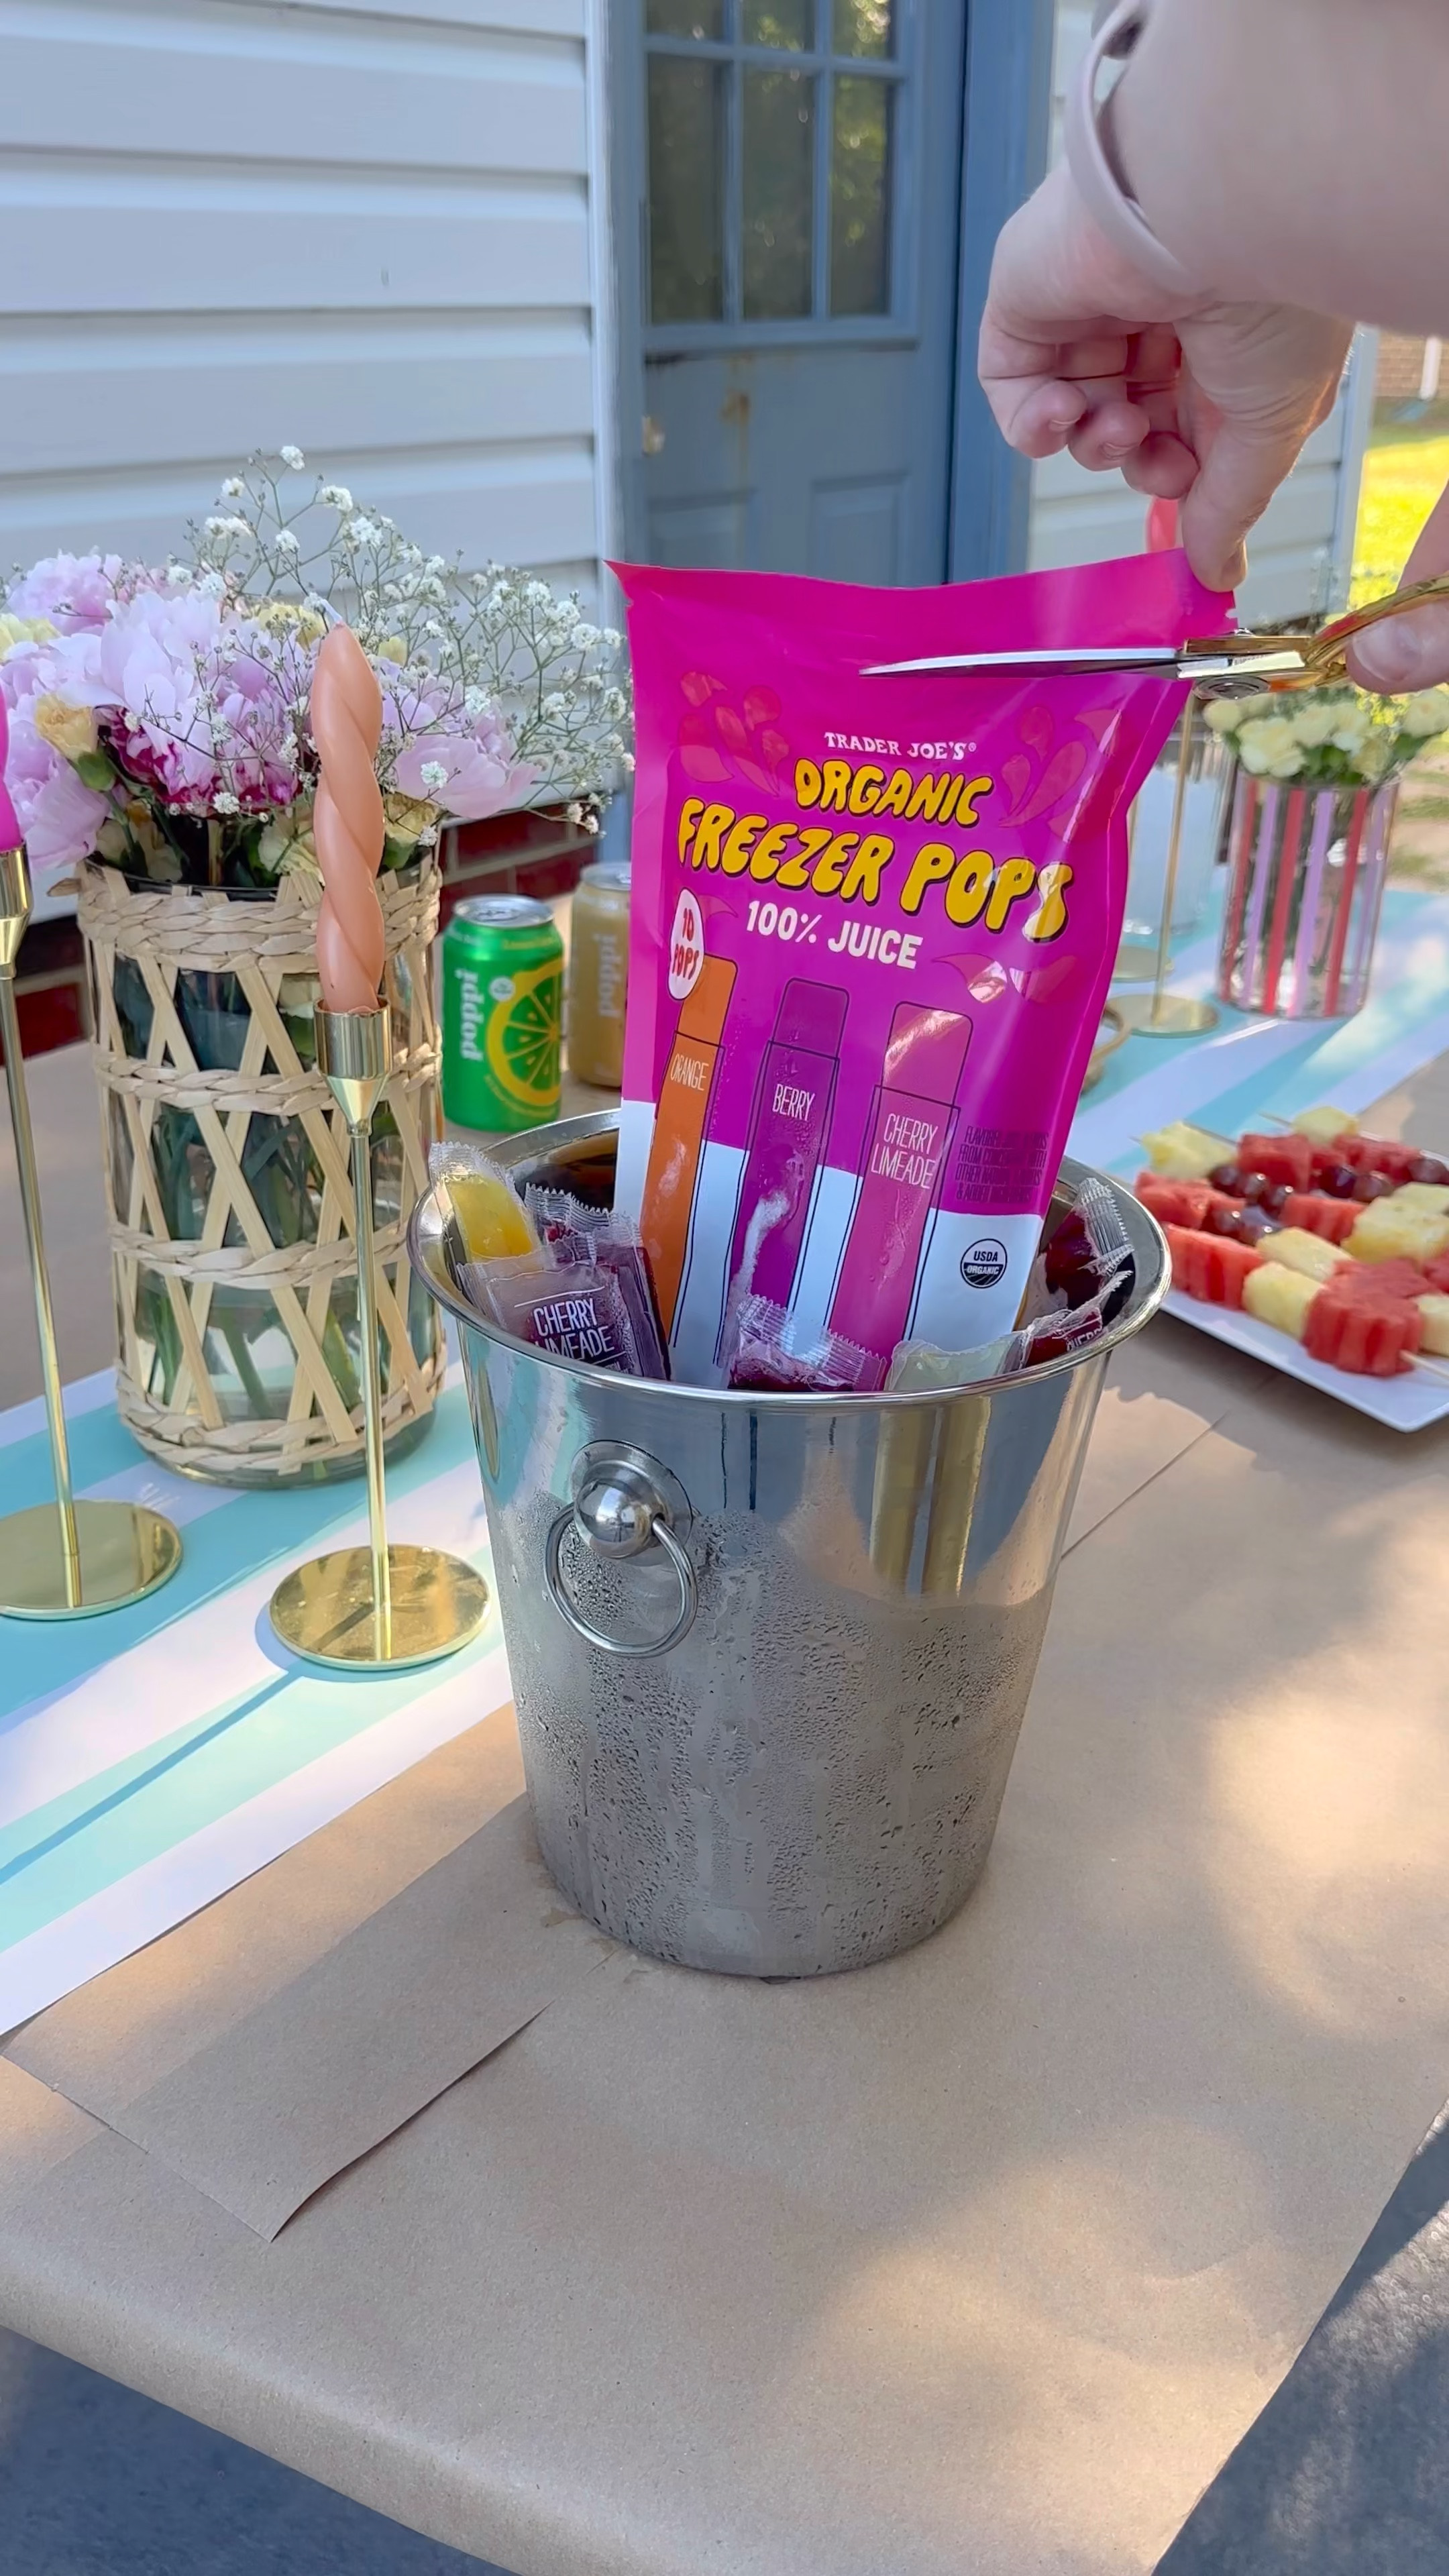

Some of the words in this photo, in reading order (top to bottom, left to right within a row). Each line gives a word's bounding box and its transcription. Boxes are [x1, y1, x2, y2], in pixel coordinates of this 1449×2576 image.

[824, 731, 902, 756] TRADER
[794, 758, 994, 827] ORGANIC
[677, 797, 895, 903] FREEZER
[899, 843, 1073, 943] POPS
[682, 907, 695, 942] 10
[746, 900, 822, 944] 100%
[827, 919, 924, 969] JUICE
[672, 943, 700, 981] POPS
[453, 967, 484, 1063] poppi
[670, 1053, 709, 1091] ORANGE
[771, 1083, 816, 1122] BERRY
[883, 1112, 938, 1155] CHERRY
[871, 1142, 936, 1189] LIMEADE
[967, 1265, 1000, 1275] ORGANIC
[973, 1250, 998, 1262] USDA
[533, 1297, 598, 1337] CHERRY
